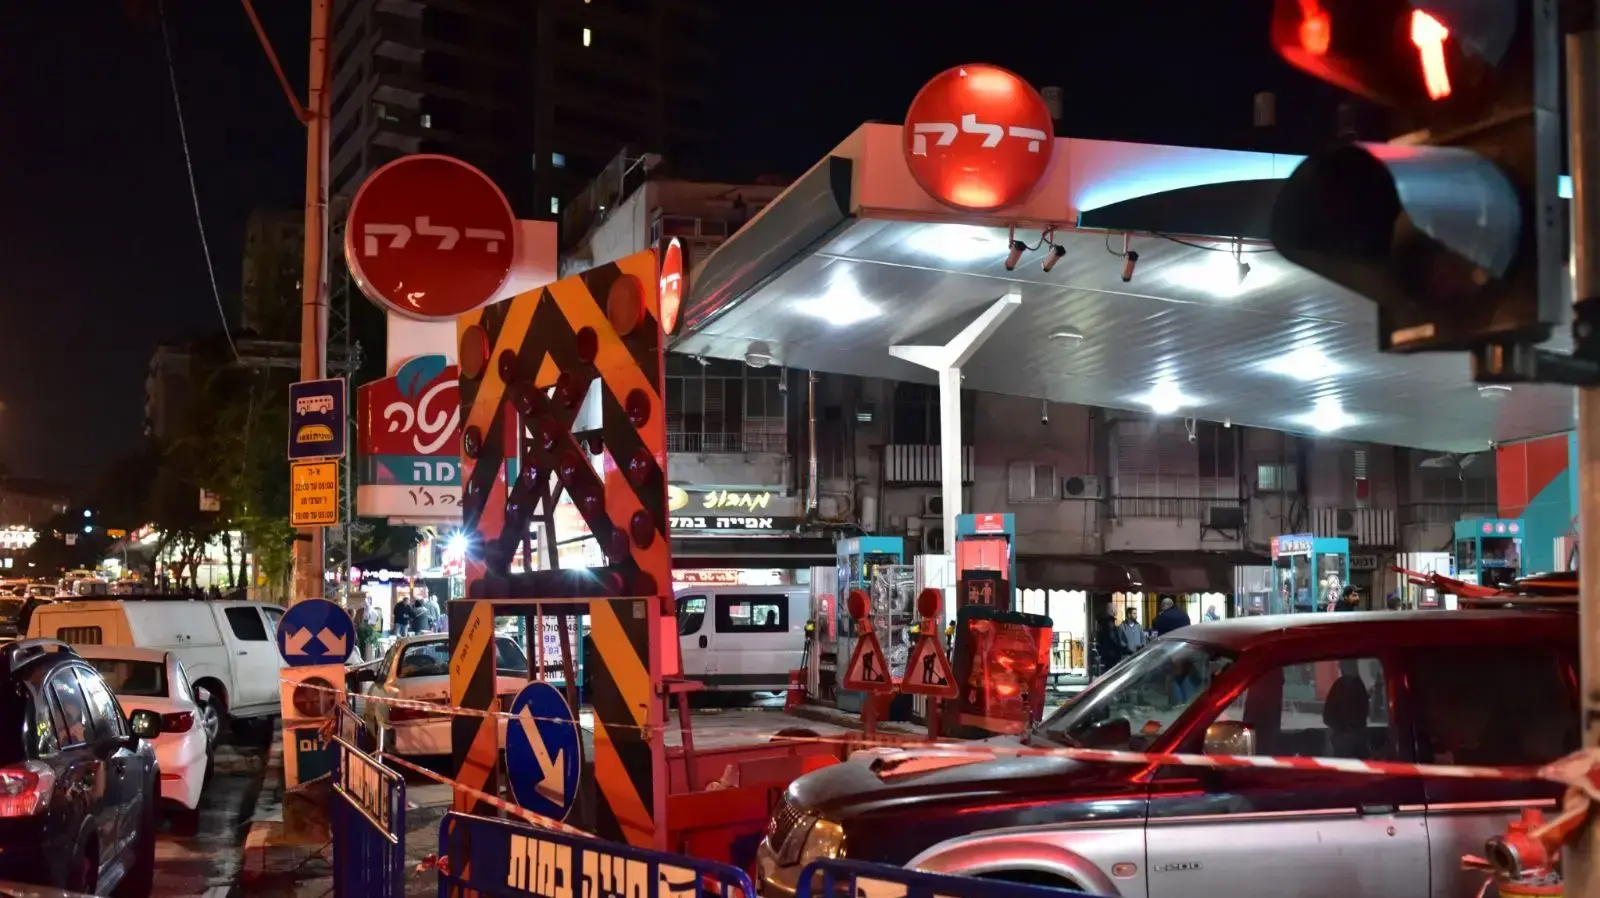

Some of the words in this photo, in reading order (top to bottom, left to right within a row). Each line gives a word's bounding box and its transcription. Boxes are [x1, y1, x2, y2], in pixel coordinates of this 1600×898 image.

[913, 114, 1047, 157] דלק
[364, 215, 506, 258] דלק
[716, 517, 773, 528] אפייה
